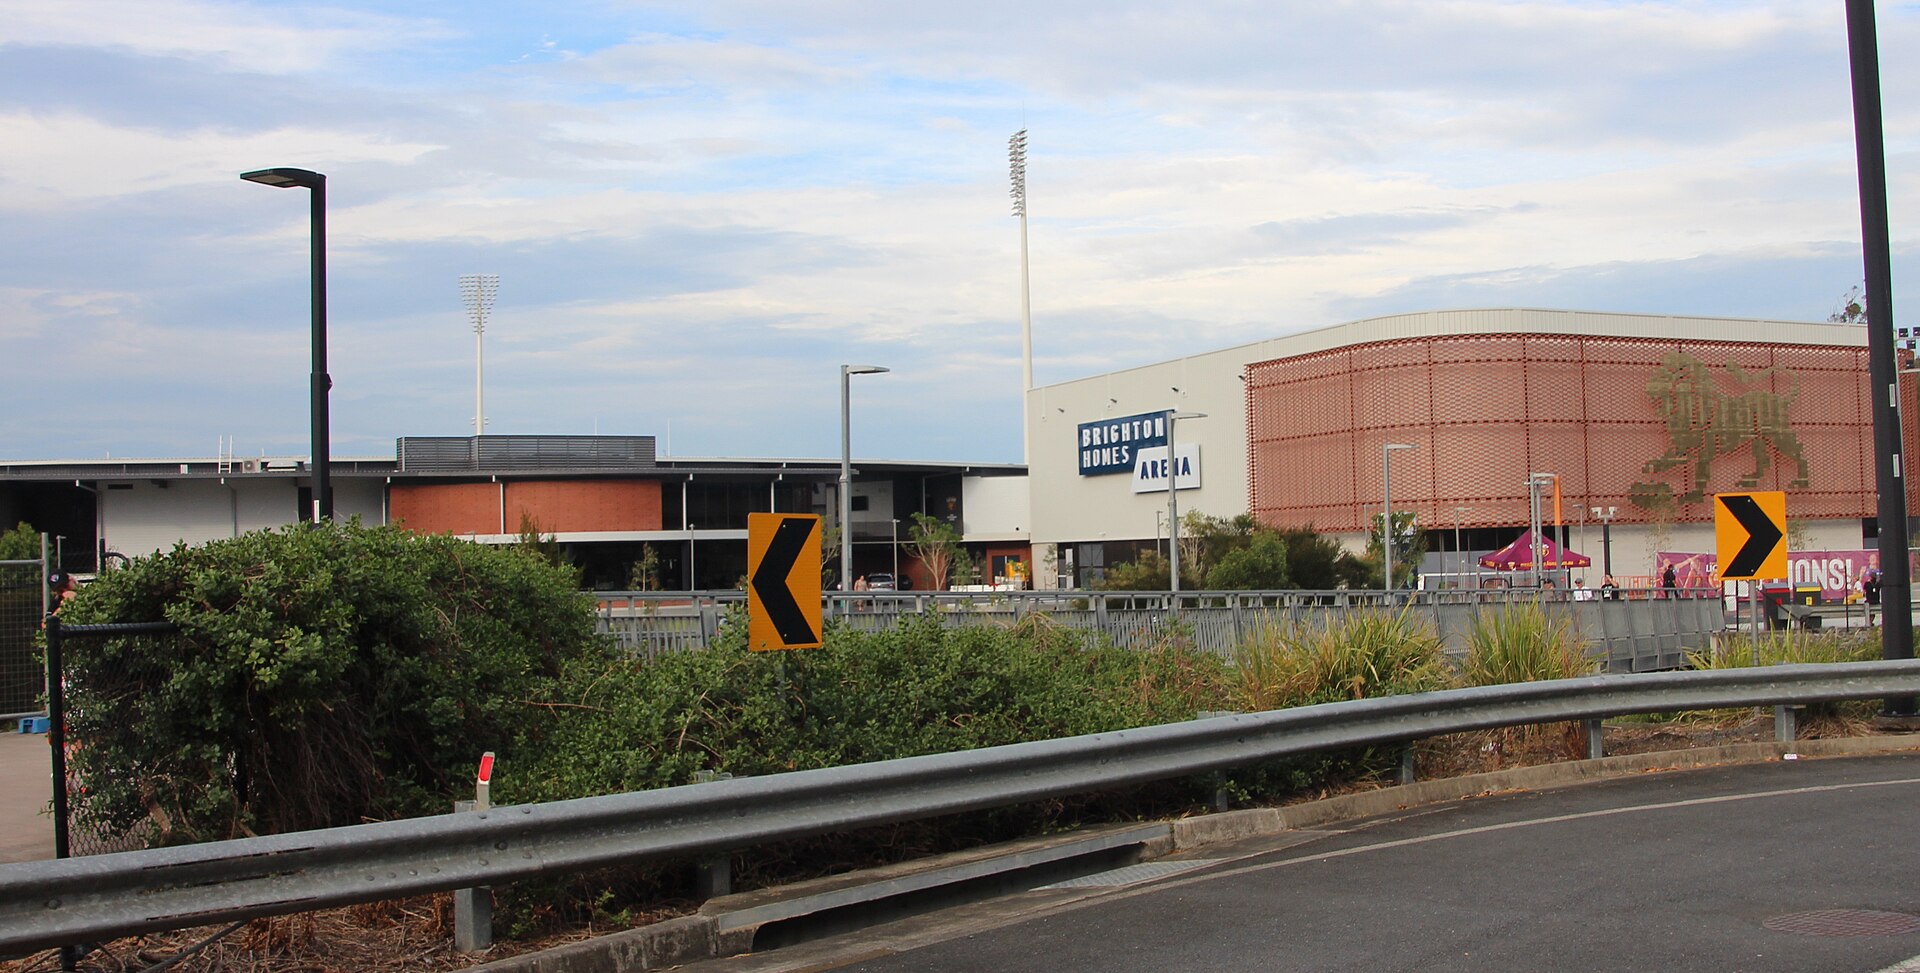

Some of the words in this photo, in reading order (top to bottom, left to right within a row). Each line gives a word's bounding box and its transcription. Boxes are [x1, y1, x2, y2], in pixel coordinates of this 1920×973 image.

[1082, 417, 1164, 447] BRIGHTON
[1083, 445, 1130, 468] HOMES
[1773, 558, 1852, 591] IONS!
